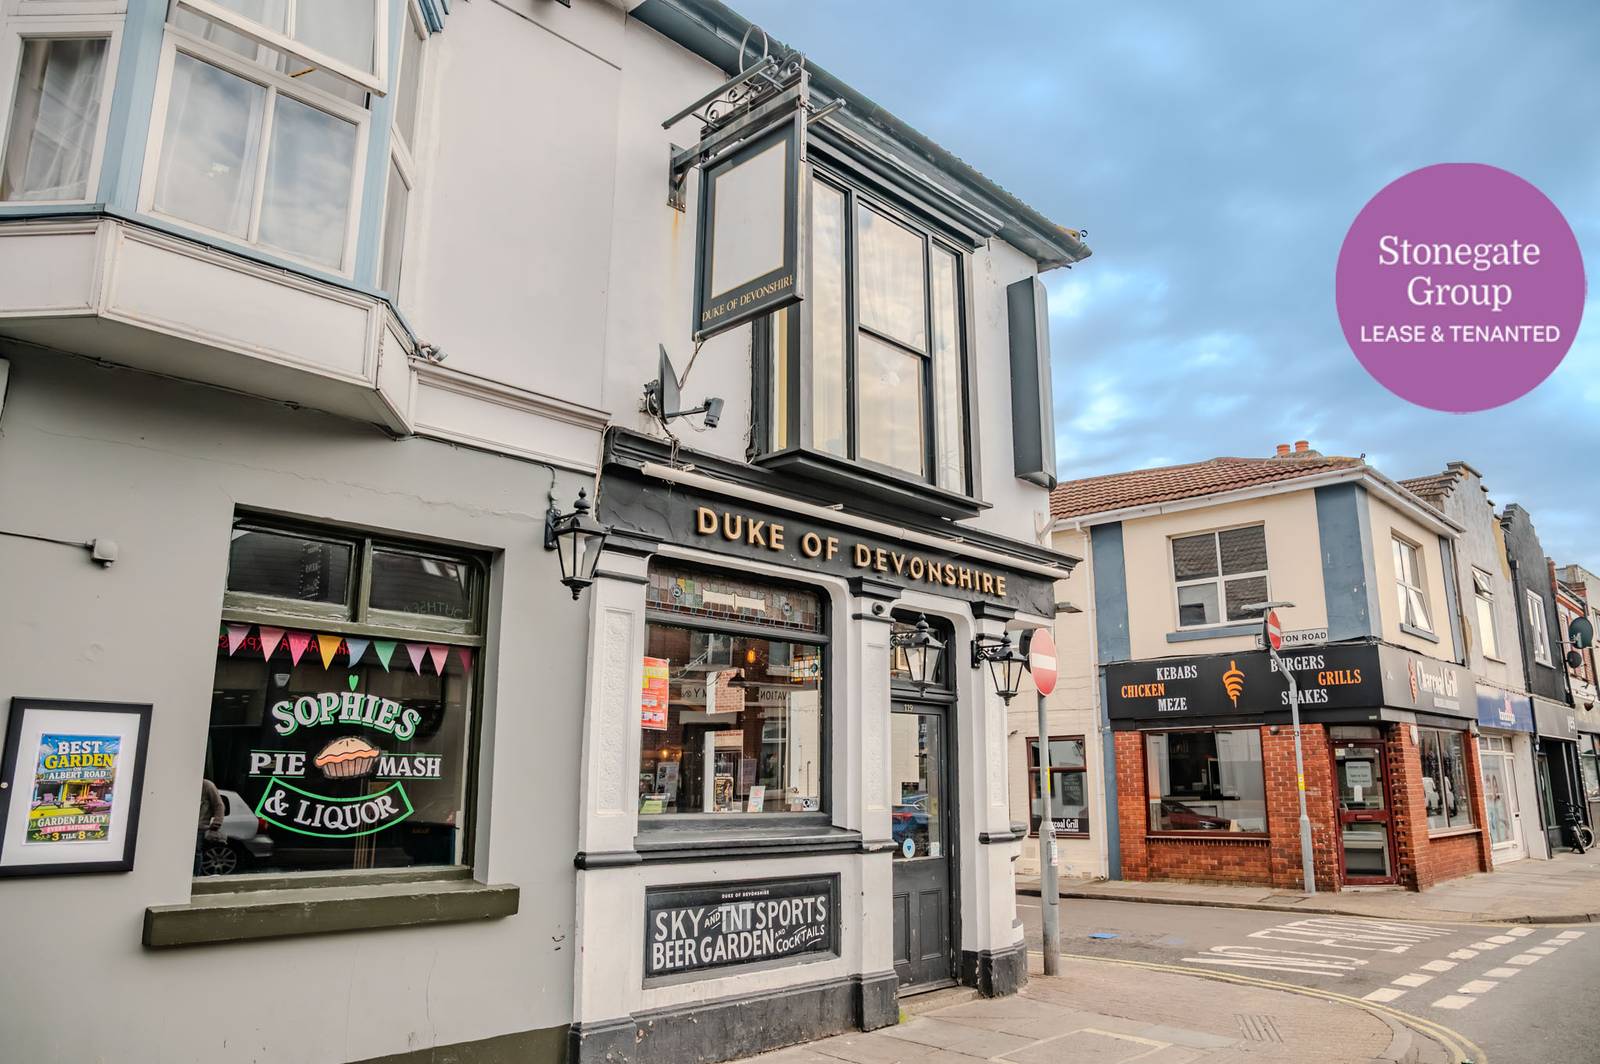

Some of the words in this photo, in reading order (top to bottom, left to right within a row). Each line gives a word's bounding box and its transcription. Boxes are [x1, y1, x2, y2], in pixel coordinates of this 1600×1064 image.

[702, 304, 725, 322] DUKE
[727, 298, 738, 311] OF
[697, 506, 785, 550] DUKE
[802, 532, 839, 560] OF
[854, 544, 1008, 597] DEVONSHIRE
[1258, 634, 1298, 645] ETON
[1301, 632, 1327, 641] ROAD
[1156, 664, 1198, 681] KEBABS
[1317, 669, 1362, 686] GRILLS
[1121, 683, 1166, 699] CHICKEN
[1158, 697, 1188, 712] MEZE
[57, 740, 103, 755] BEST
[44, 753, 113, 770] GARDEN
[250, 752, 306, 776] PIE
[377, 756, 442, 777] MASH
[48, 771, 82, 780] ALBERT
[83, 770, 107, 779] ROAD
[264, 789, 290, 817] &
[293, 795, 399, 831] LIQUOR
[37, 816, 76, 828] GARDEN
[78, 814, 107, 825] PARTY
[1066, 819, 1079, 829] Grill
[52, 832, 60, 841] 3
[78, 831, 86, 840] 8
[654, 908, 705, 942] SKY
[704, 912, 721, 929] AND
[756, 896, 827, 929] SPORTS
[776, 924, 825, 953] COCKTAILS
[652, 938, 698, 970] BEER
[700, 928, 774, 963] GARDEN
[775, 929, 786, 938] AND
